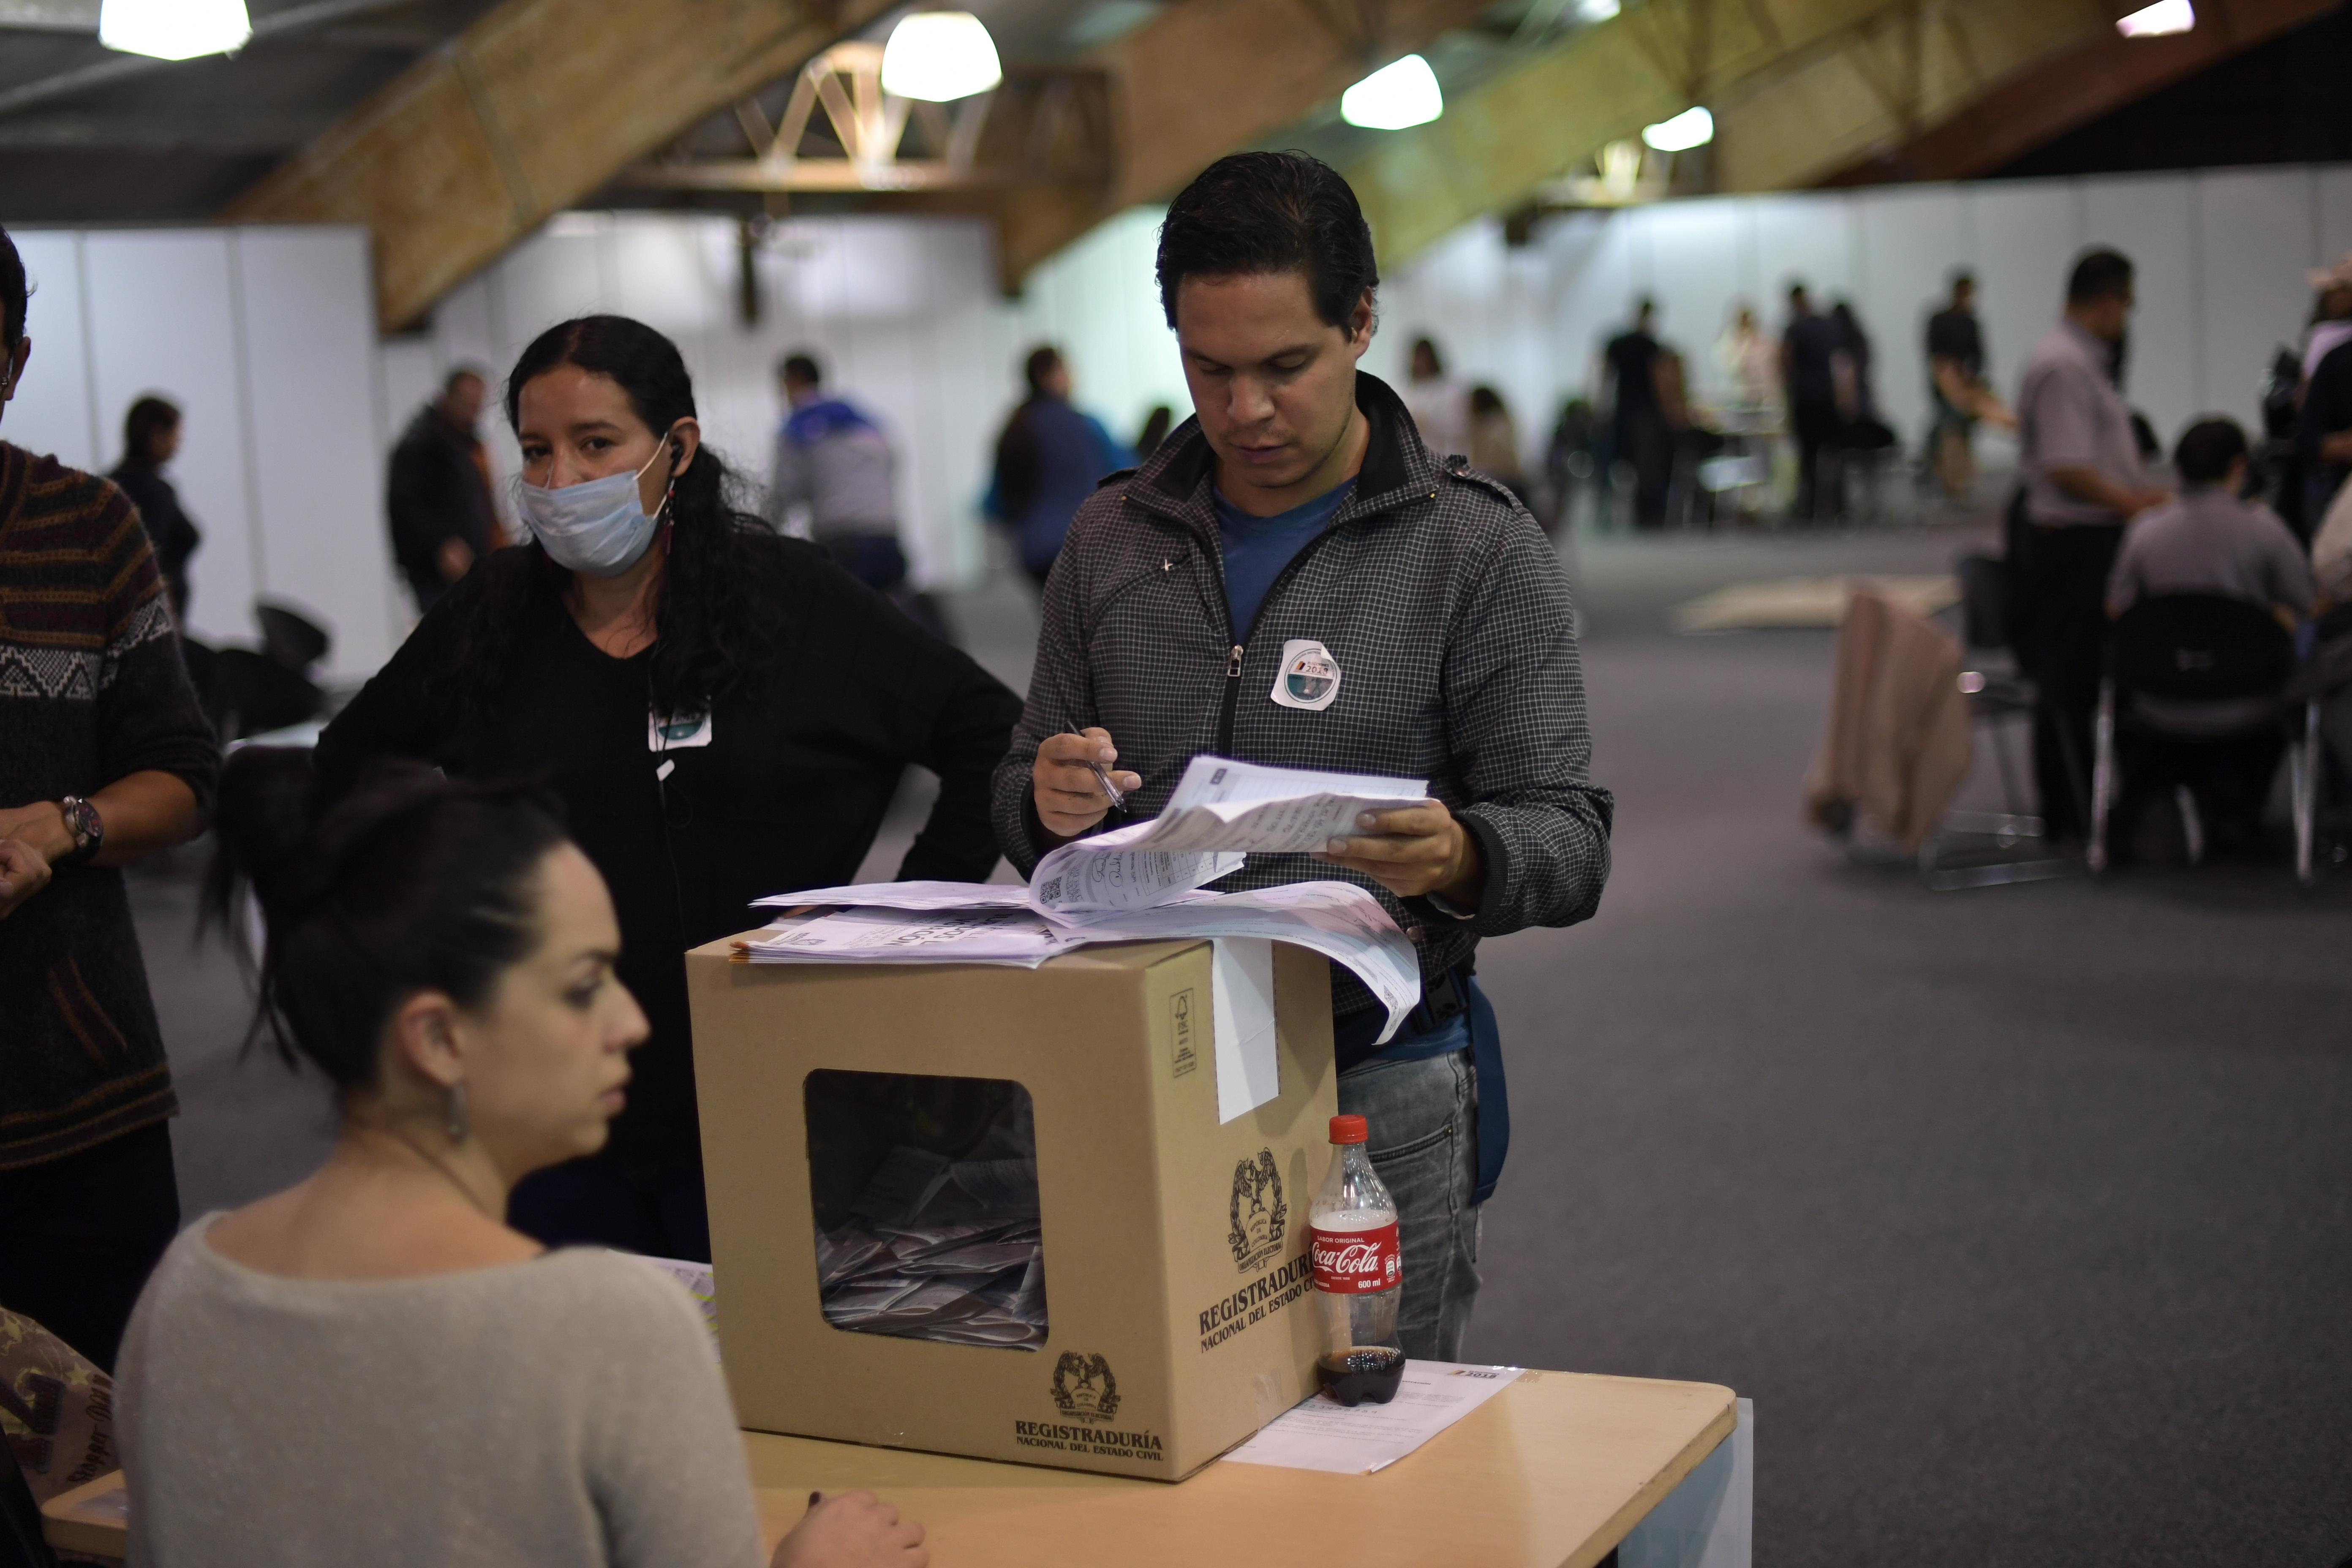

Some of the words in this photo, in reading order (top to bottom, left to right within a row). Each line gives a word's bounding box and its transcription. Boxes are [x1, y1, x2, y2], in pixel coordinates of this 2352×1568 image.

[1305, 666, 1328, 675] 2018
[1250, 1219, 1266, 1233] REPÚBLICA
[1252, 1234, 1268, 1247] COLOMBIA
[1239, 1249, 1263, 1271] ORGANIZACIÓN
[1264, 1241, 1282, 1255] ELECTORAL
[1312, 1241, 1382, 1273] Coca-Cola
[1199, 1242, 1313, 1336] REGISTRADURÍ
[1358, 1280, 1371, 1288] 600
[1372, 1278, 1380, 1287] ml
[1201, 1317, 1246, 1354] NACIONAL
[1248, 1305, 1266, 1326] DEL
[1269, 1284, 1302, 1314] ESTADO
[1015, 1420, 1162, 1450] REGISTRADURÍA
[1017, 1437, 1067, 1450] NACIONAL
[1070, 1443, 1090, 1453] DEL
[1093, 1446, 1133, 1457] ESTADO
[1136, 1451, 1164, 1461] CIVIL
